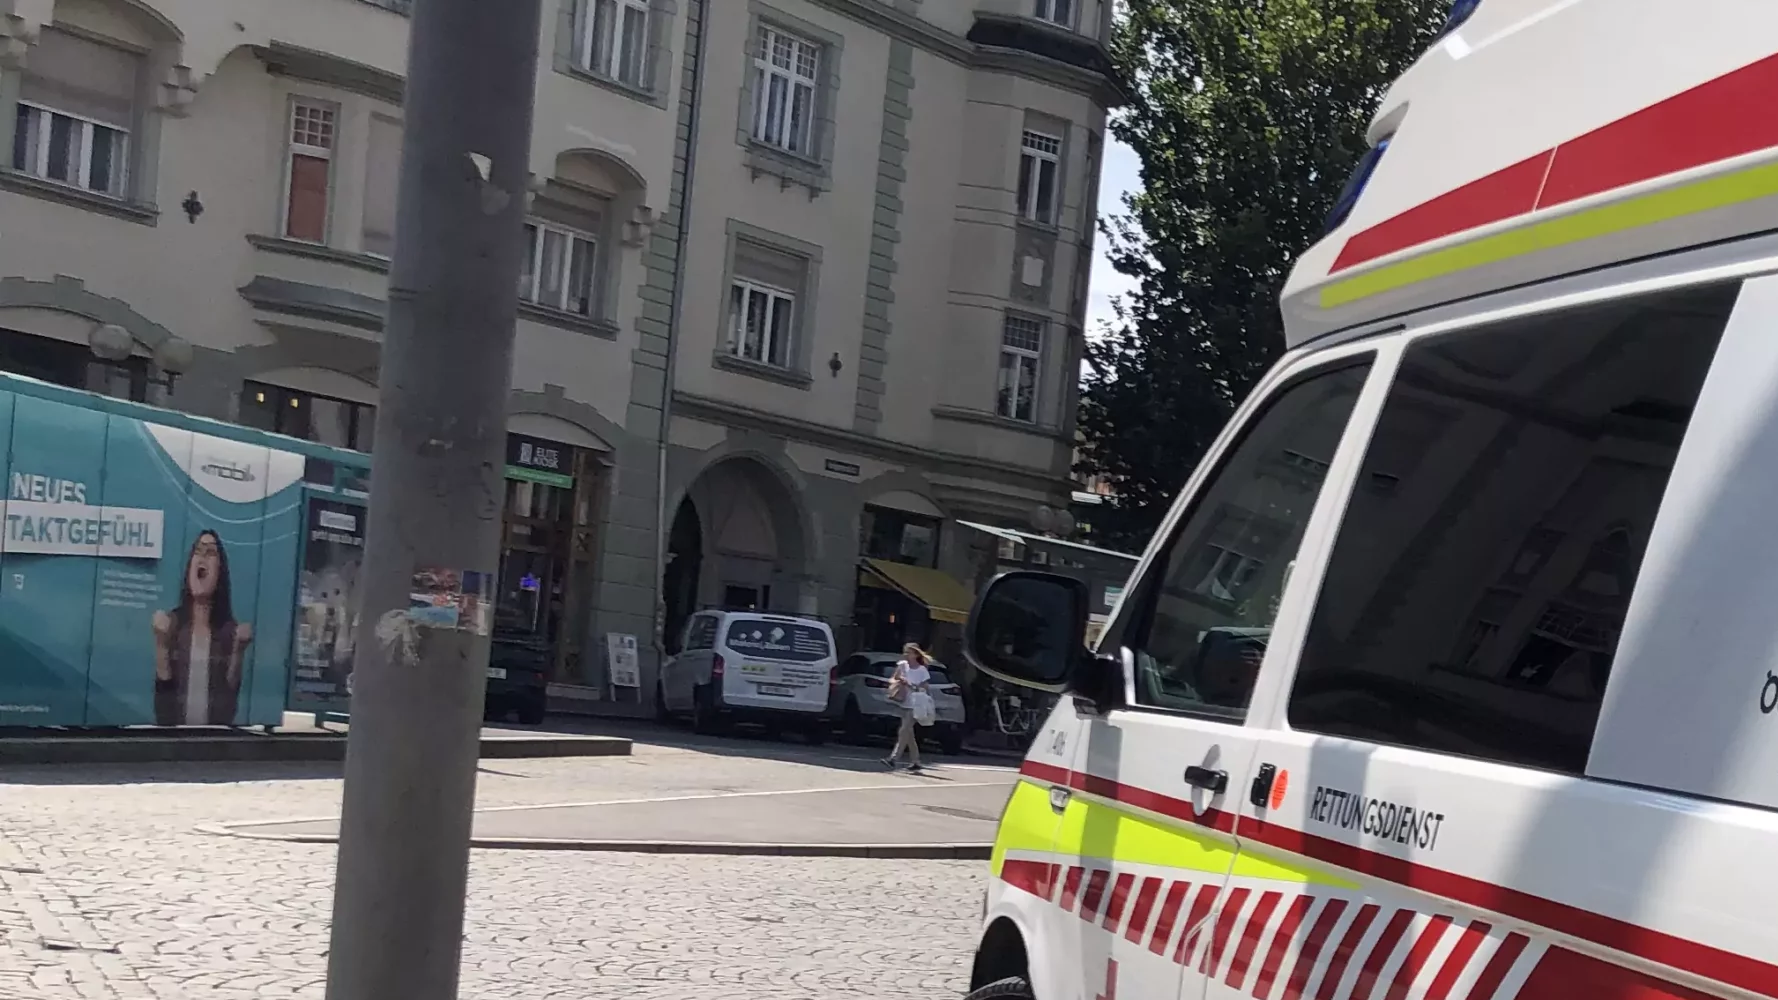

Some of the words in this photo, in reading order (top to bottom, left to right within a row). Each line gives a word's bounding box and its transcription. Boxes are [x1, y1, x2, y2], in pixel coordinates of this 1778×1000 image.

[12, 472, 87, 505] NEUES
[7, 514, 155, 548] TAKTGEFÜHL
[1309, 786, 1445, 851] RETTUNGSDIENST
